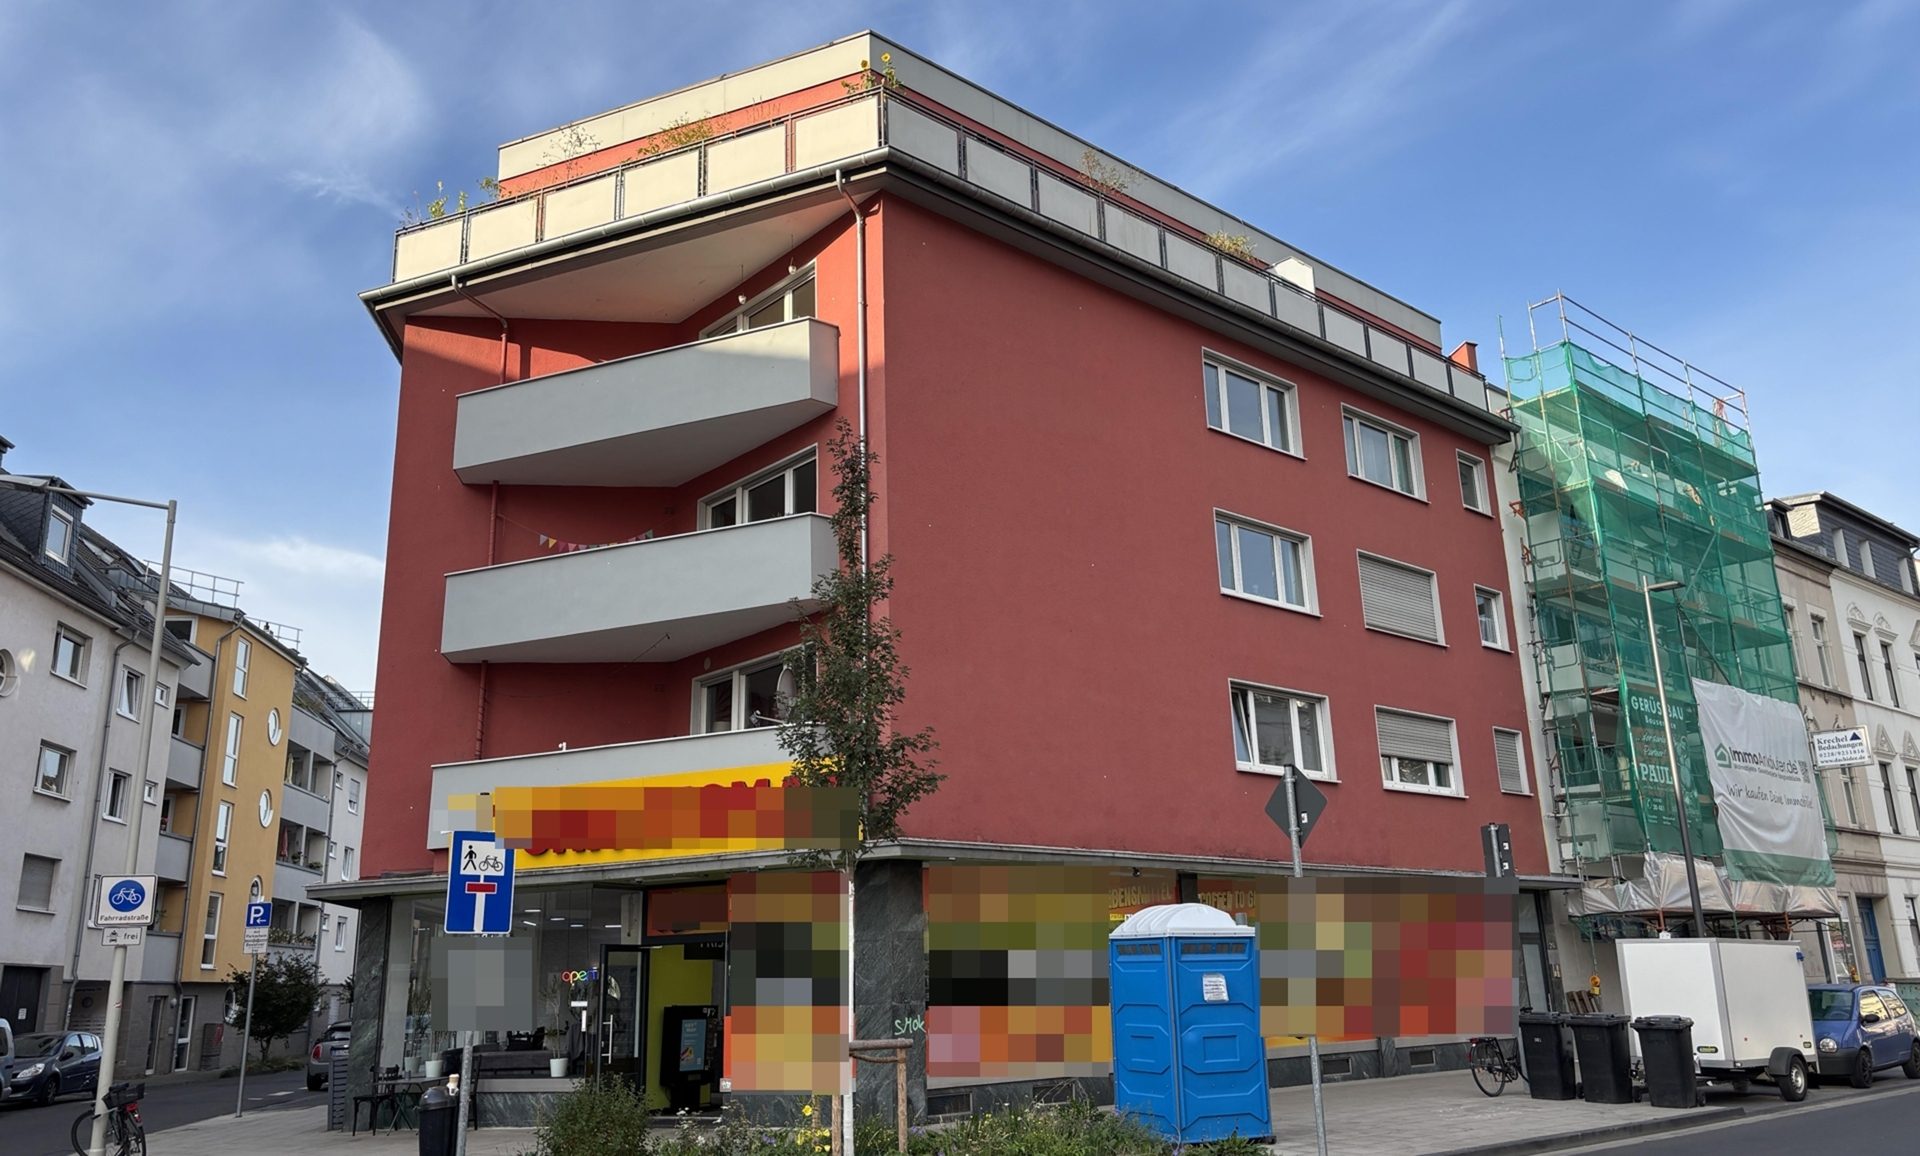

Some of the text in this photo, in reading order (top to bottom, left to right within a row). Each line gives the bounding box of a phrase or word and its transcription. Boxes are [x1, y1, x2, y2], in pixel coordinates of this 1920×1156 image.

[1631, 696, 1684, 720] GERÜSBAU
[1817, 735, 1848, 744] Krechel
[1818, 742, 1863, 751] Bedachungen
[1727, 784, 1743, 797] Wir
[1745, 785, 1769, 801] kaufen
[1235, 890, 1245, 909] TO
[250, 906, 264, 924] P
[124, 932, 138, 940] frei
[562, 970, 599, 984] open
